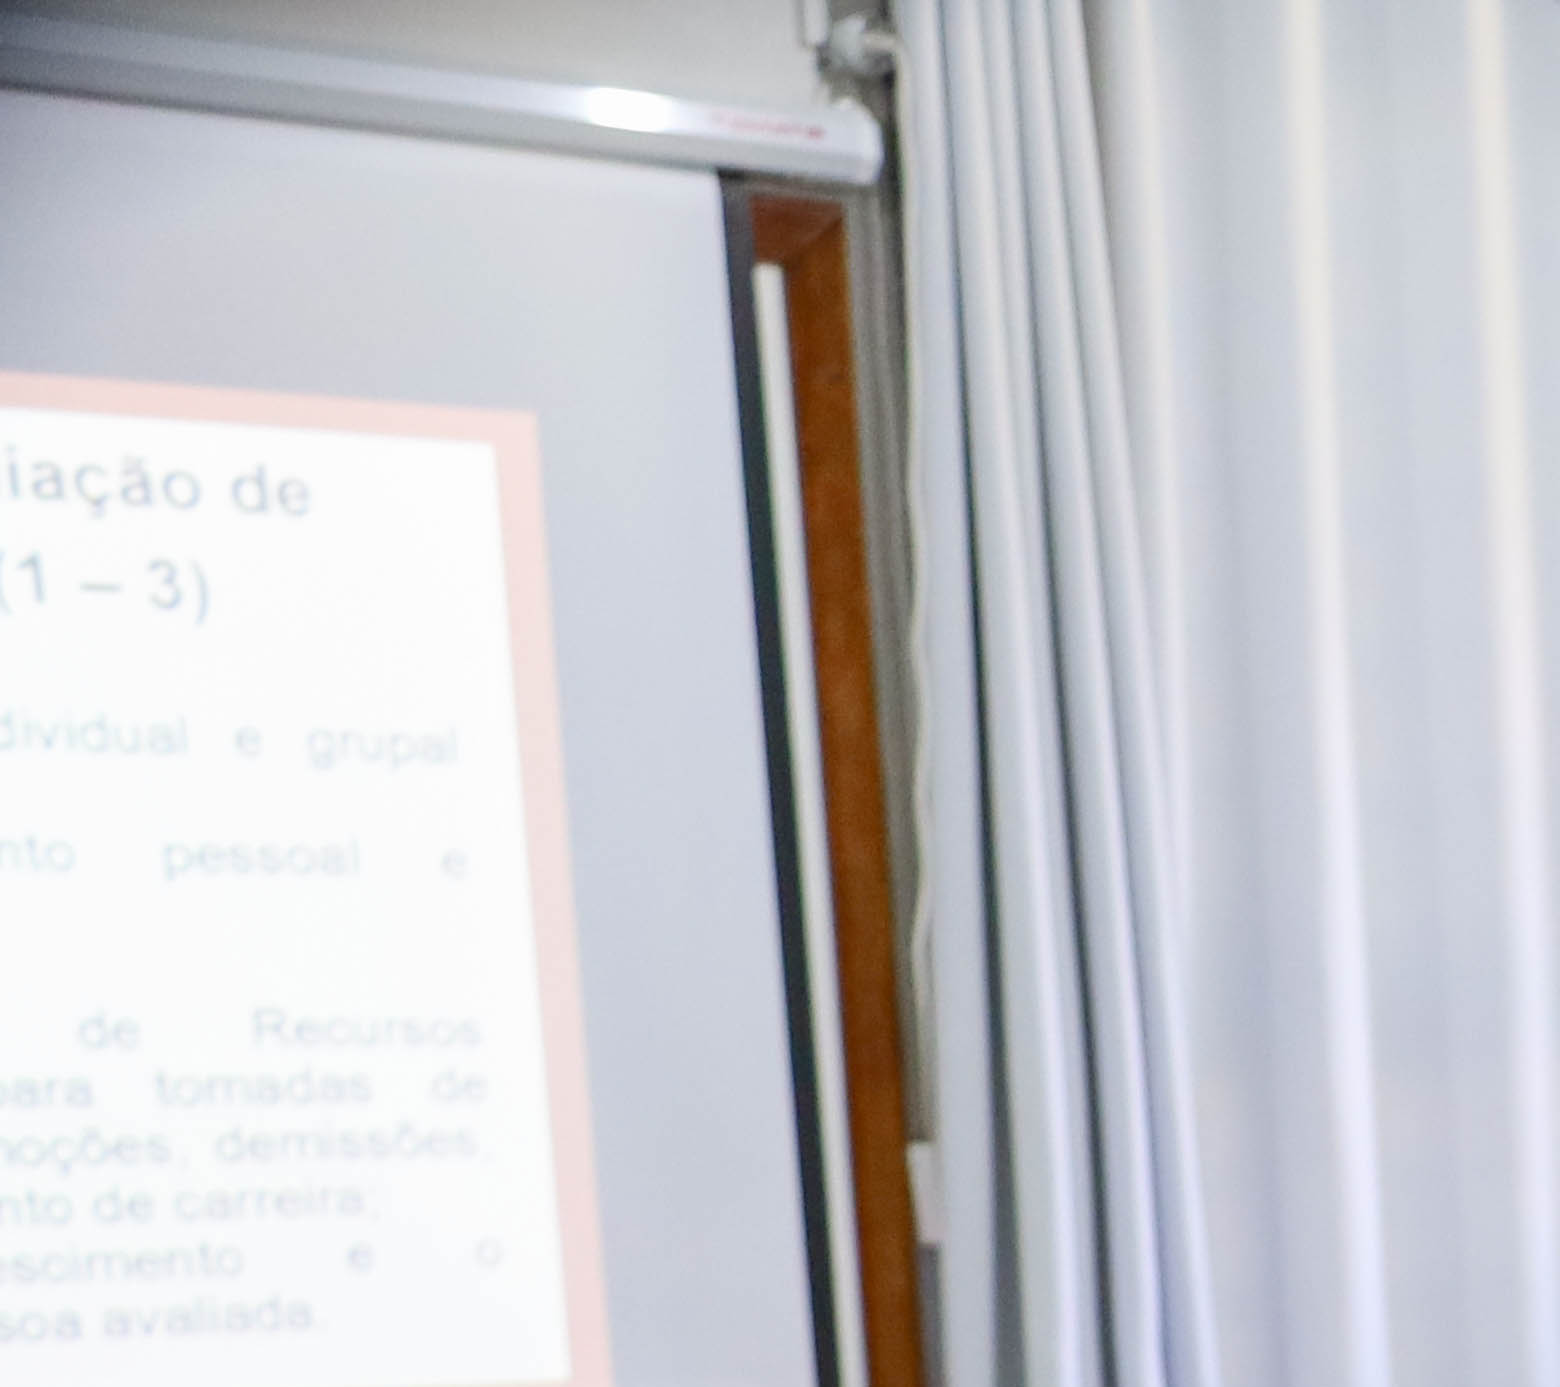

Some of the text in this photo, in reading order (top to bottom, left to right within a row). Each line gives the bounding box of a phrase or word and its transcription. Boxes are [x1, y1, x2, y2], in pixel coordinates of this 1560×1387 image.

[230, 462, 314, 516] de
[147, 555, 213, 626] 3)
[233, 724, 262, 757] e
[305, 720, 459, 770] grupal
[163, 836, 361, 883] pessoal
[440, 847, 469, 880] e
[77, 1006, 482, 1051] de Recursos
[154, 1067, 373, 1108] tomadas
[430, 1067, 489, 1104] de
[92, 1183, 154, 1226] de
[344, 1241, 375, 1276] e
